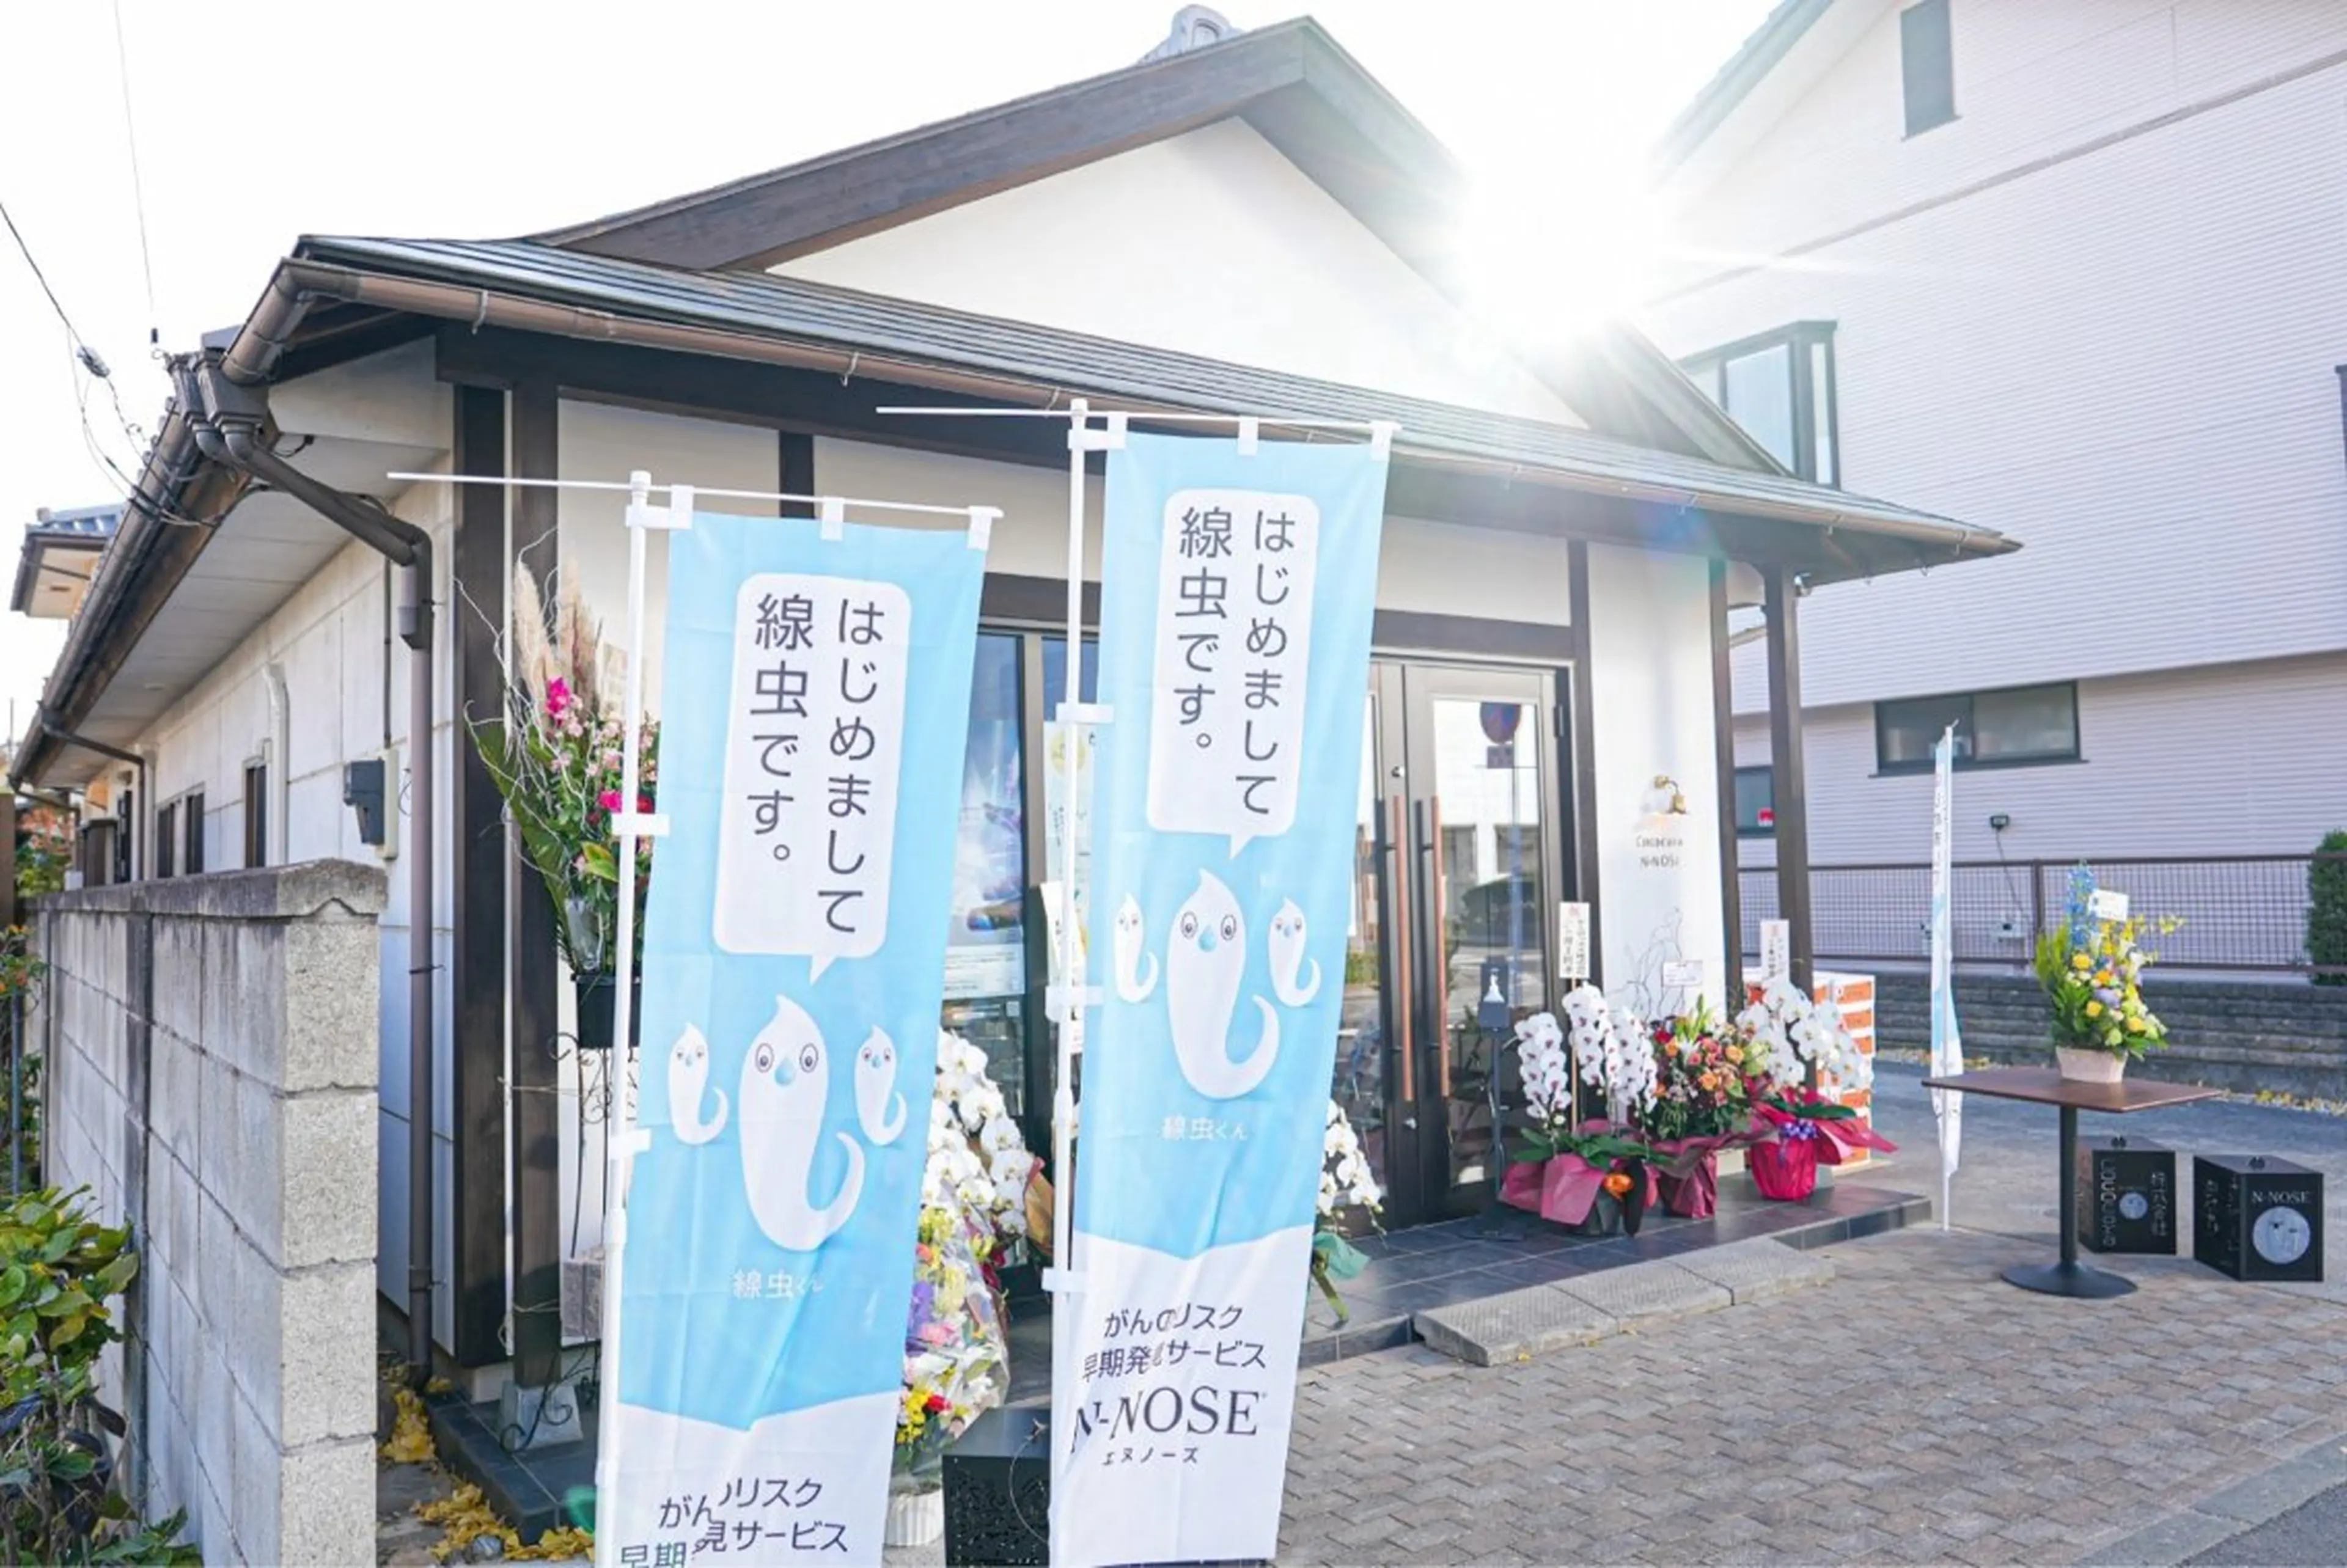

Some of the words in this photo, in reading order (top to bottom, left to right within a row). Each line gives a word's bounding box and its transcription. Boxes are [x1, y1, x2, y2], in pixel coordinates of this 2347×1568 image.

[746, 593, 815, 861] 線虫です。
[1173, 506, 1233, 749] 線虫です。
[1235, 509, 1296, 815] はじめまして
[817, 598, 885, 934] はじめまして
[2250, 1190, 2312, 1204] N-NOSE
